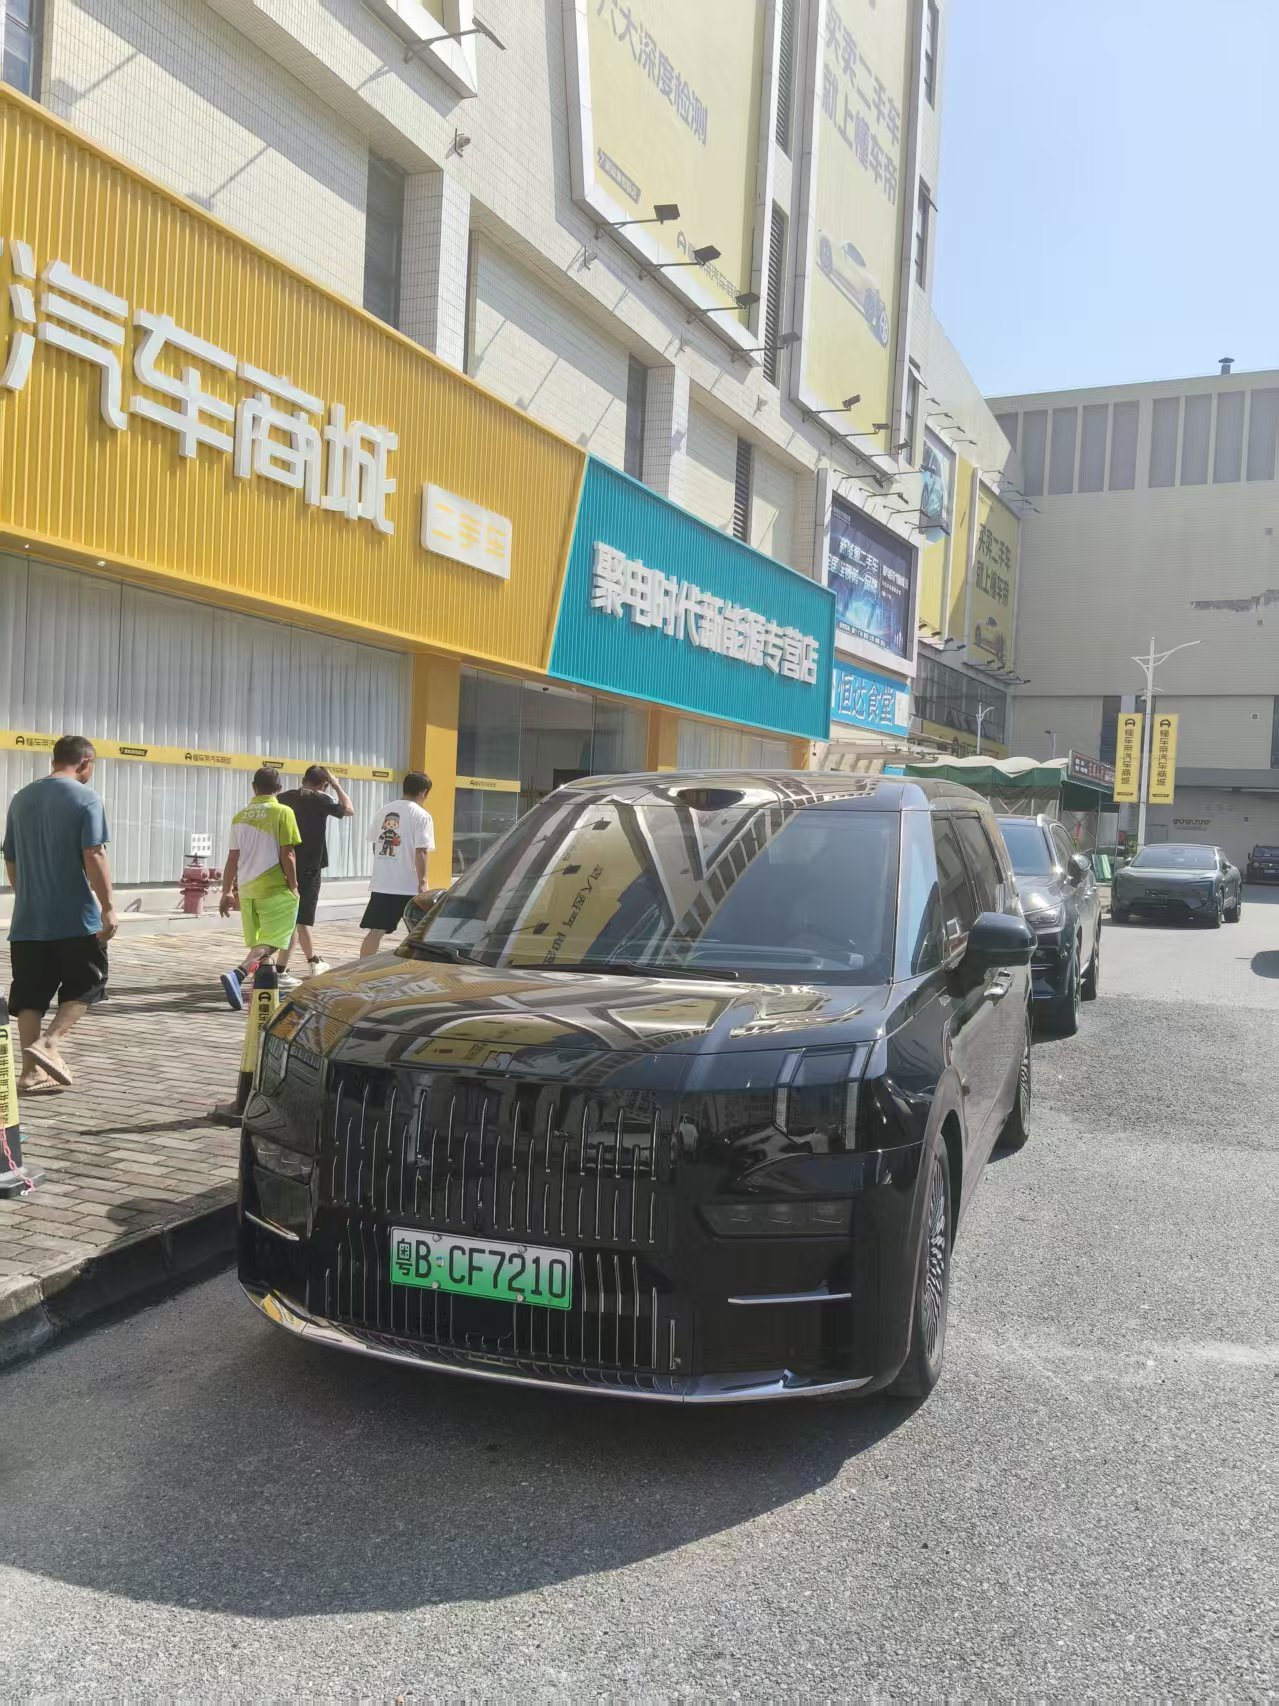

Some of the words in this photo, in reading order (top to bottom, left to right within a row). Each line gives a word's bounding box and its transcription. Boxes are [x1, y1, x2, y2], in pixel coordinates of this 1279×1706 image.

[1, 238, 398, 536] 汽车商城
[838, 671, 895, 726] 恒达食堂
